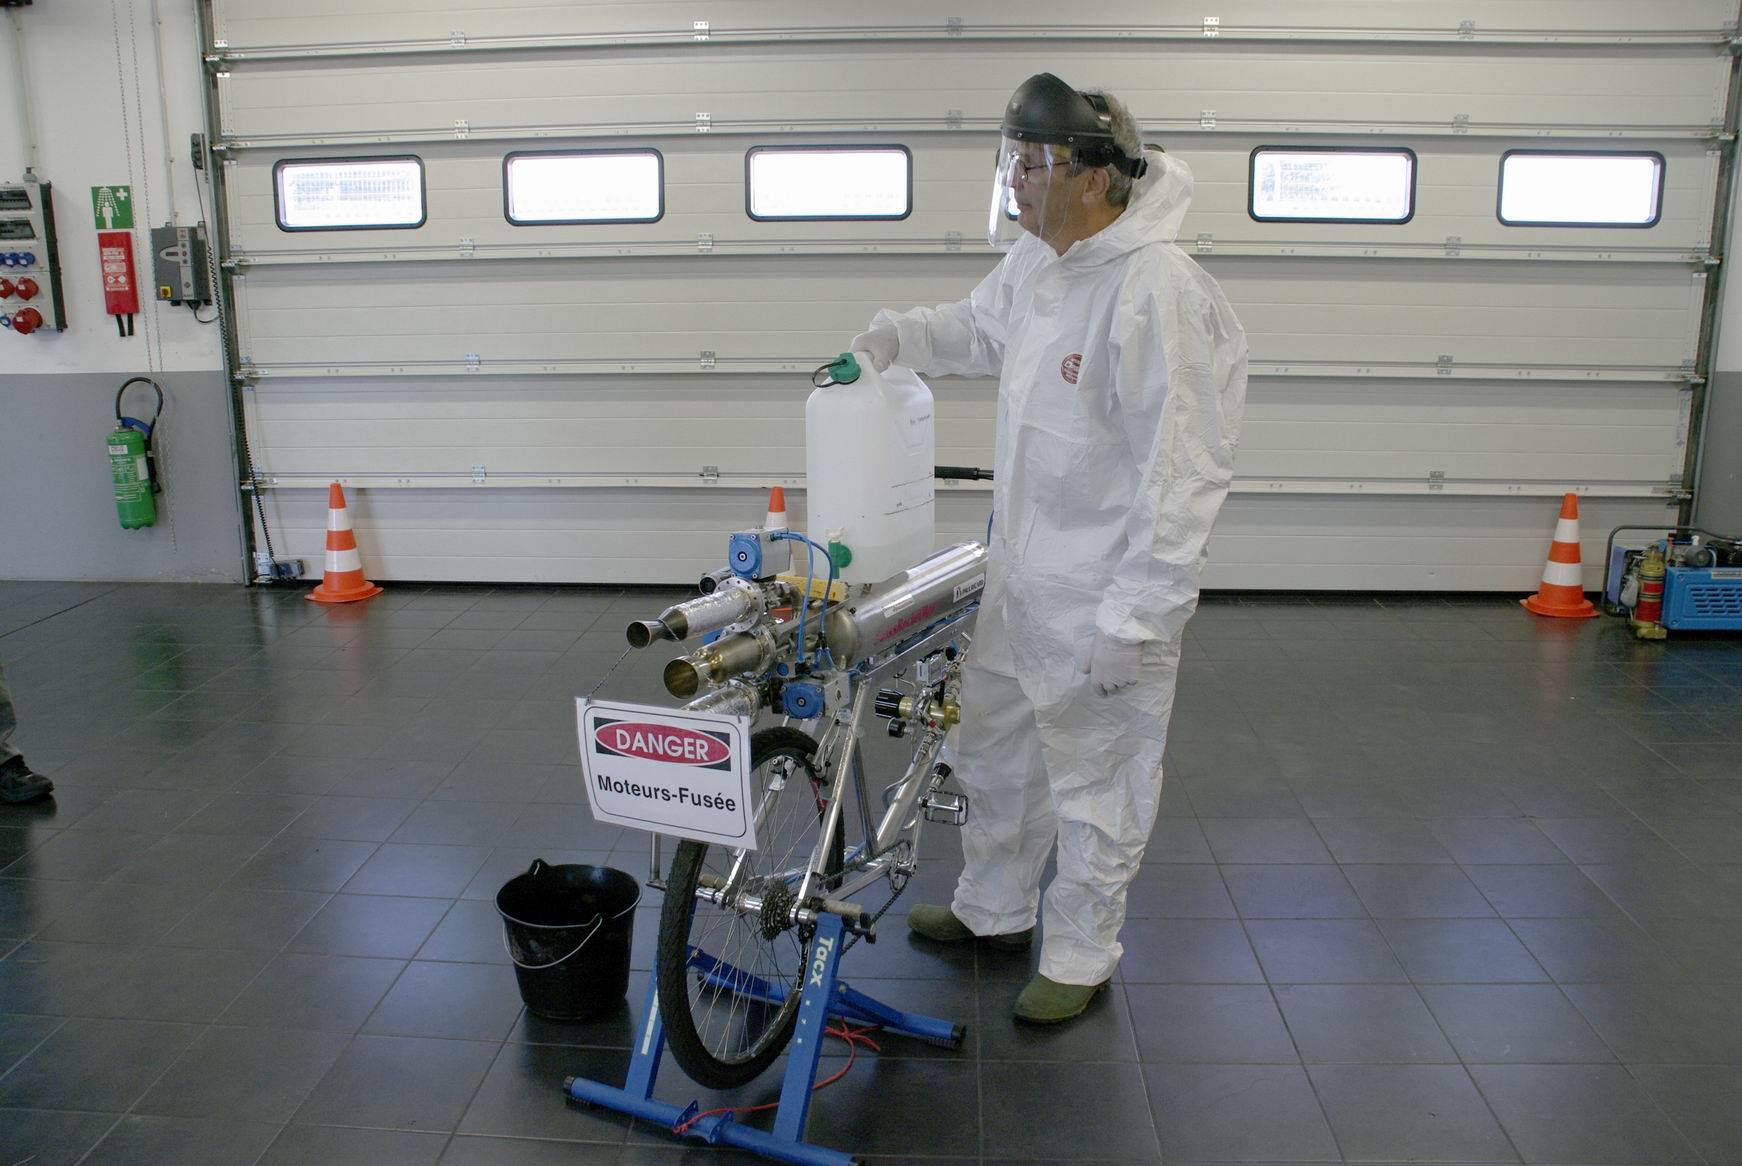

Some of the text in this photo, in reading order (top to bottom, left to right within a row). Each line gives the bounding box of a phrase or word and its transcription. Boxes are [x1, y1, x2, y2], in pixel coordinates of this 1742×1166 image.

[616, 729, 710, 761] DANGER
[597, 774, 737, 812] Moteurs-Fusée
[811, 937, 834, 987] Tacx
